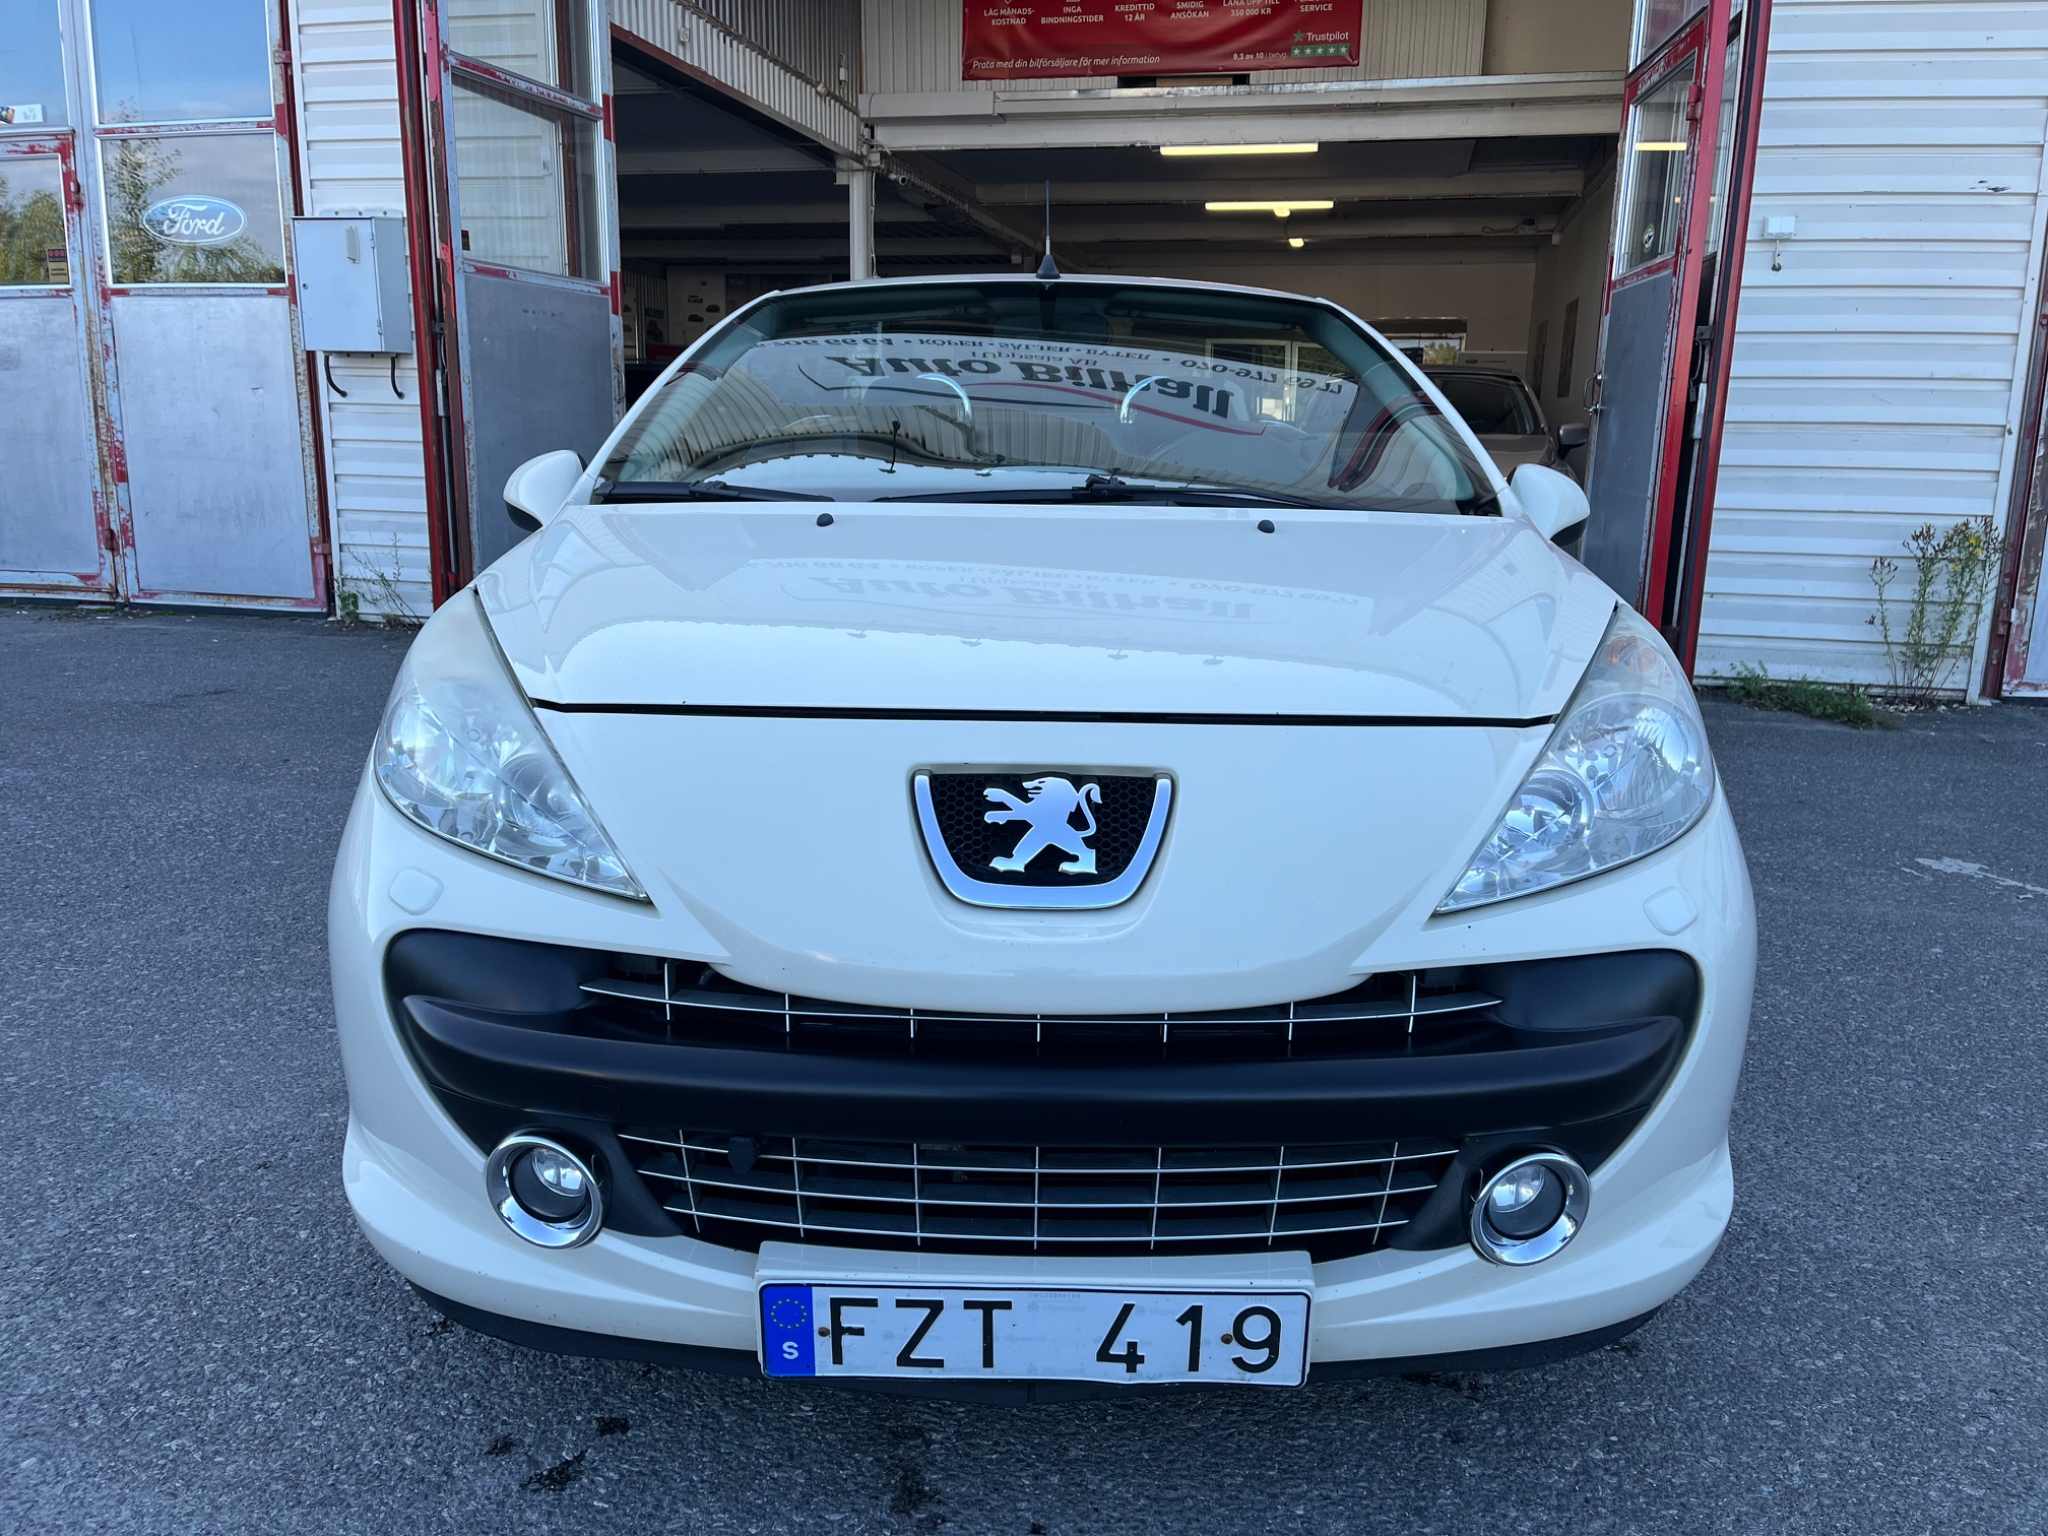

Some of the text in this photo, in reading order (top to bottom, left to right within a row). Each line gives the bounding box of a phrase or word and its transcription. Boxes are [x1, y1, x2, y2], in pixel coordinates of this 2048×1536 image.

[1114, 3, 1155, 12] KREDITTID
[1176, 1, 1204, 9] SMIDIG
[1300, 4, 1333, 12] SERVICE
[984, 7, 1035, 17] LÅG MÅNADS-
[1170, 10, 1209, 19] ANSÖKAN
[1245, 8, 1260, 16] 000
[991, 17, 1026, 26] KOSTNAD
[1040, 14, 1104, 25] BINDNINGSTIDER
[1124, 13, 1146, 22] 12 ÅR
[1306, 31, 1349, 42] Trustpilot
[972, 54, 1160, 70] Prata med din bilförsäljare för mer information
[163, 203, 225, 236] Ford
[782, 1297, 1282, 1374] S FZT 419
